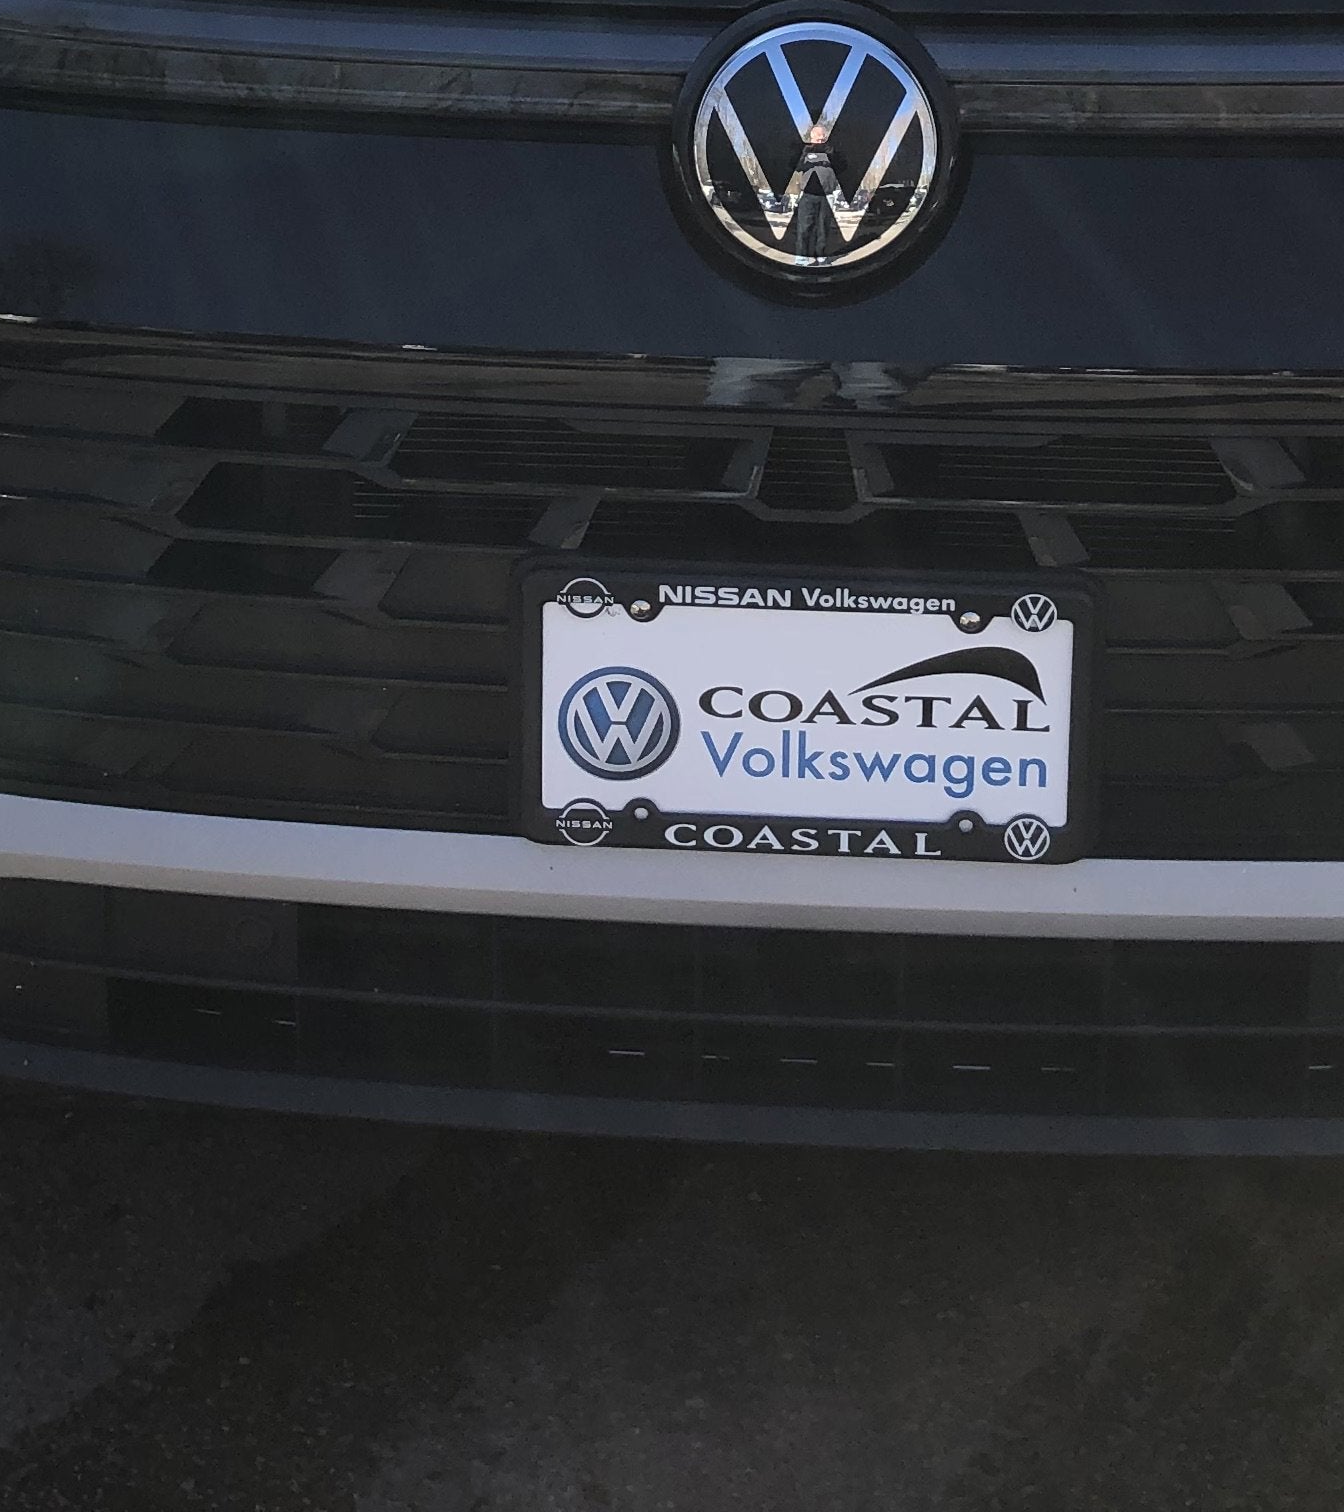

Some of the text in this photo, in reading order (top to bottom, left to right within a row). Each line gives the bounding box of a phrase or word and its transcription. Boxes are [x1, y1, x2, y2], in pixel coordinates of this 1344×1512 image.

[700, 32, 932, 250] VW
[556, 593, 614, 604] NISSAN
[658, 584, 956, 615] NISSAN Volkswagen
[1013, 595, 1057, 631] VW
[569, 674, 674, 773] VW
[698, 686, 1051, 732] COASTAL
[701, 730, 1048, 799] Volkswagen
[556, 819, 613, 829] NISSAN
[664, 823, 942, 856] COASTAL
[1006, 819, 1049, 858] VW
